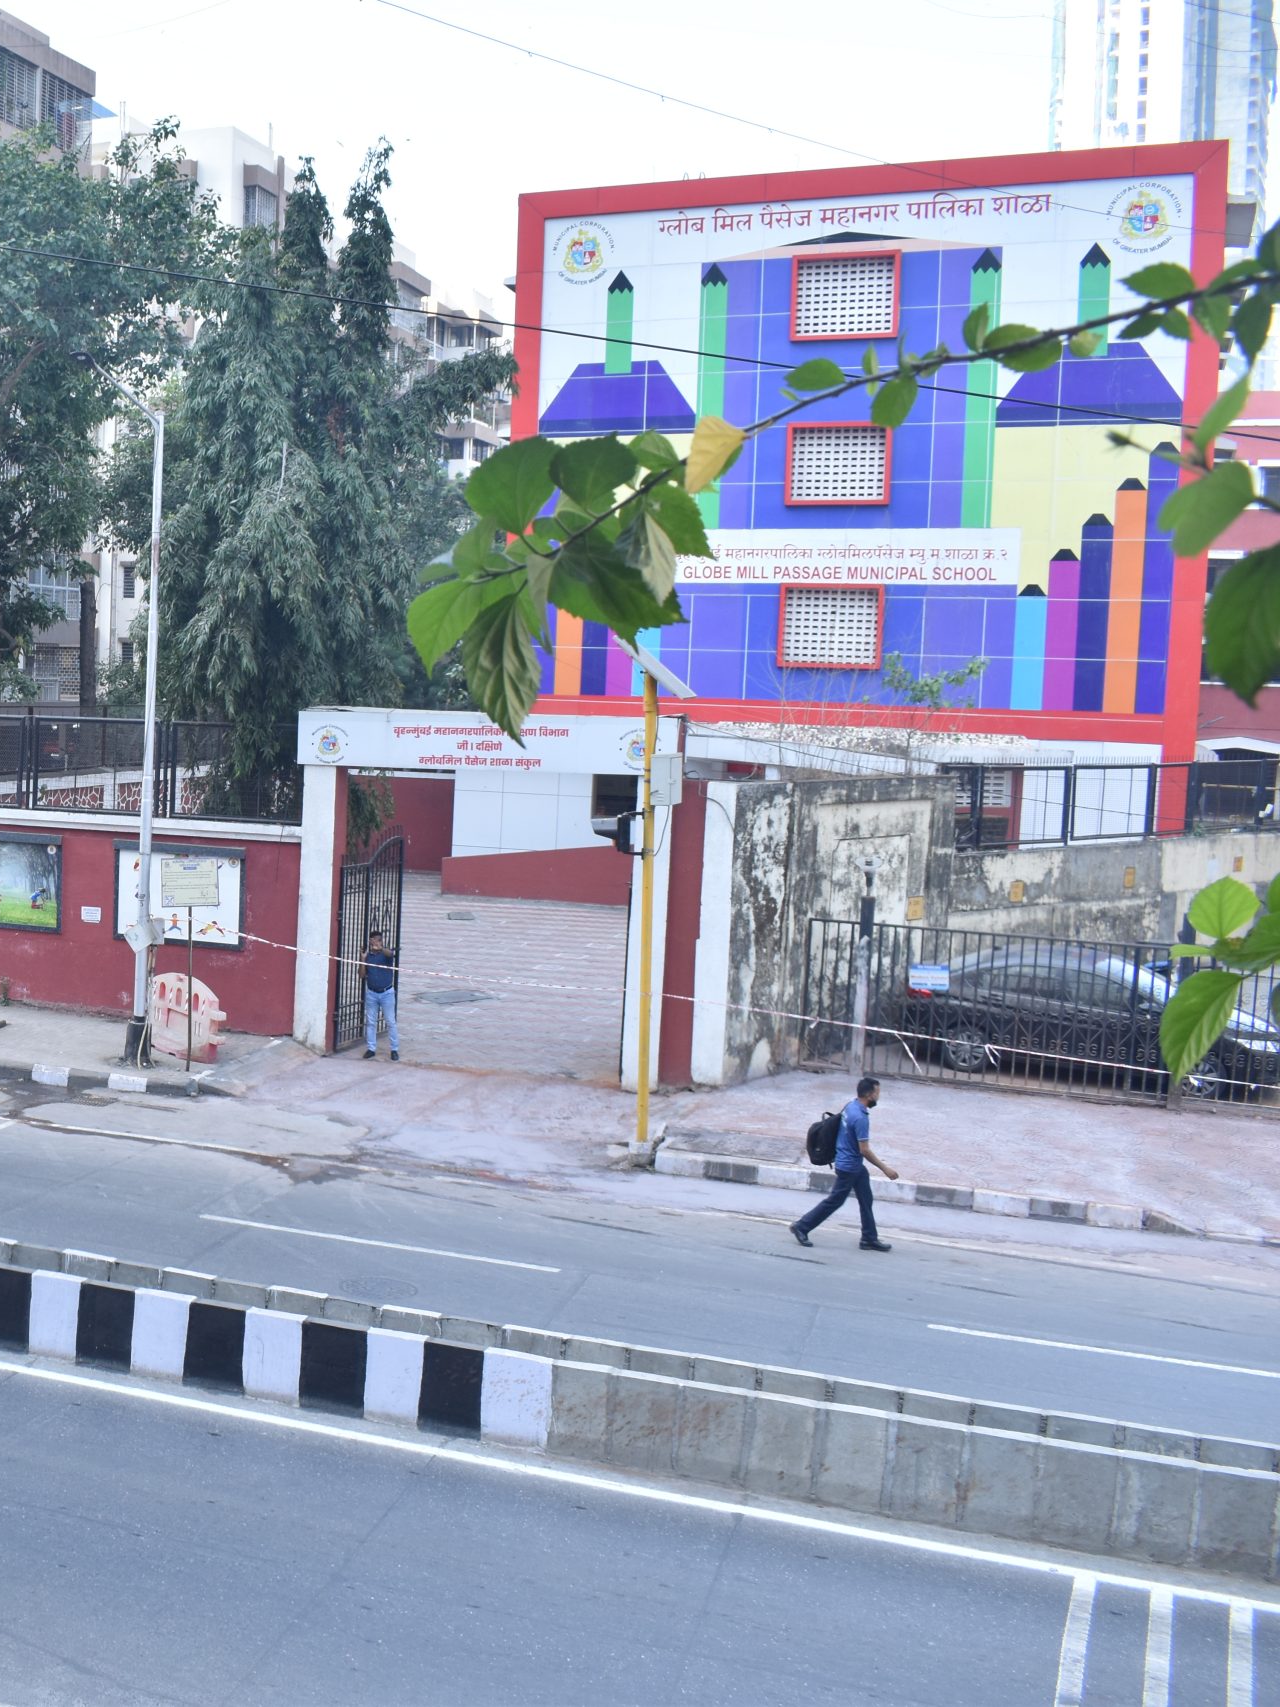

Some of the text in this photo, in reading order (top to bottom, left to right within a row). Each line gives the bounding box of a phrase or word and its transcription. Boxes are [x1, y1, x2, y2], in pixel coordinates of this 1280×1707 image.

[1106, 182, 1183, 216] MUNICIPAL CORPORATION
[658, 192, 1052, 236] ग्लोब मिल पैसेज महानगर पालिका शाळा
[552, 220, 615, 251] MUNICIPAL CORPORATION
[1119, 244, 1149, 254] GREATER
[725, 544, 813, 560] महानगरपालिका
[683, 566, 997, 581] GLOBE MILL PASSAGE MUNICIPAL SCHOOL
[393, 725, 432, 738] बृहन्मुंबई
[539, 726, 569, 737] विभाग
[489, 757, 513, 767] शाळा
[514, 756, 542, 770] संकुल
